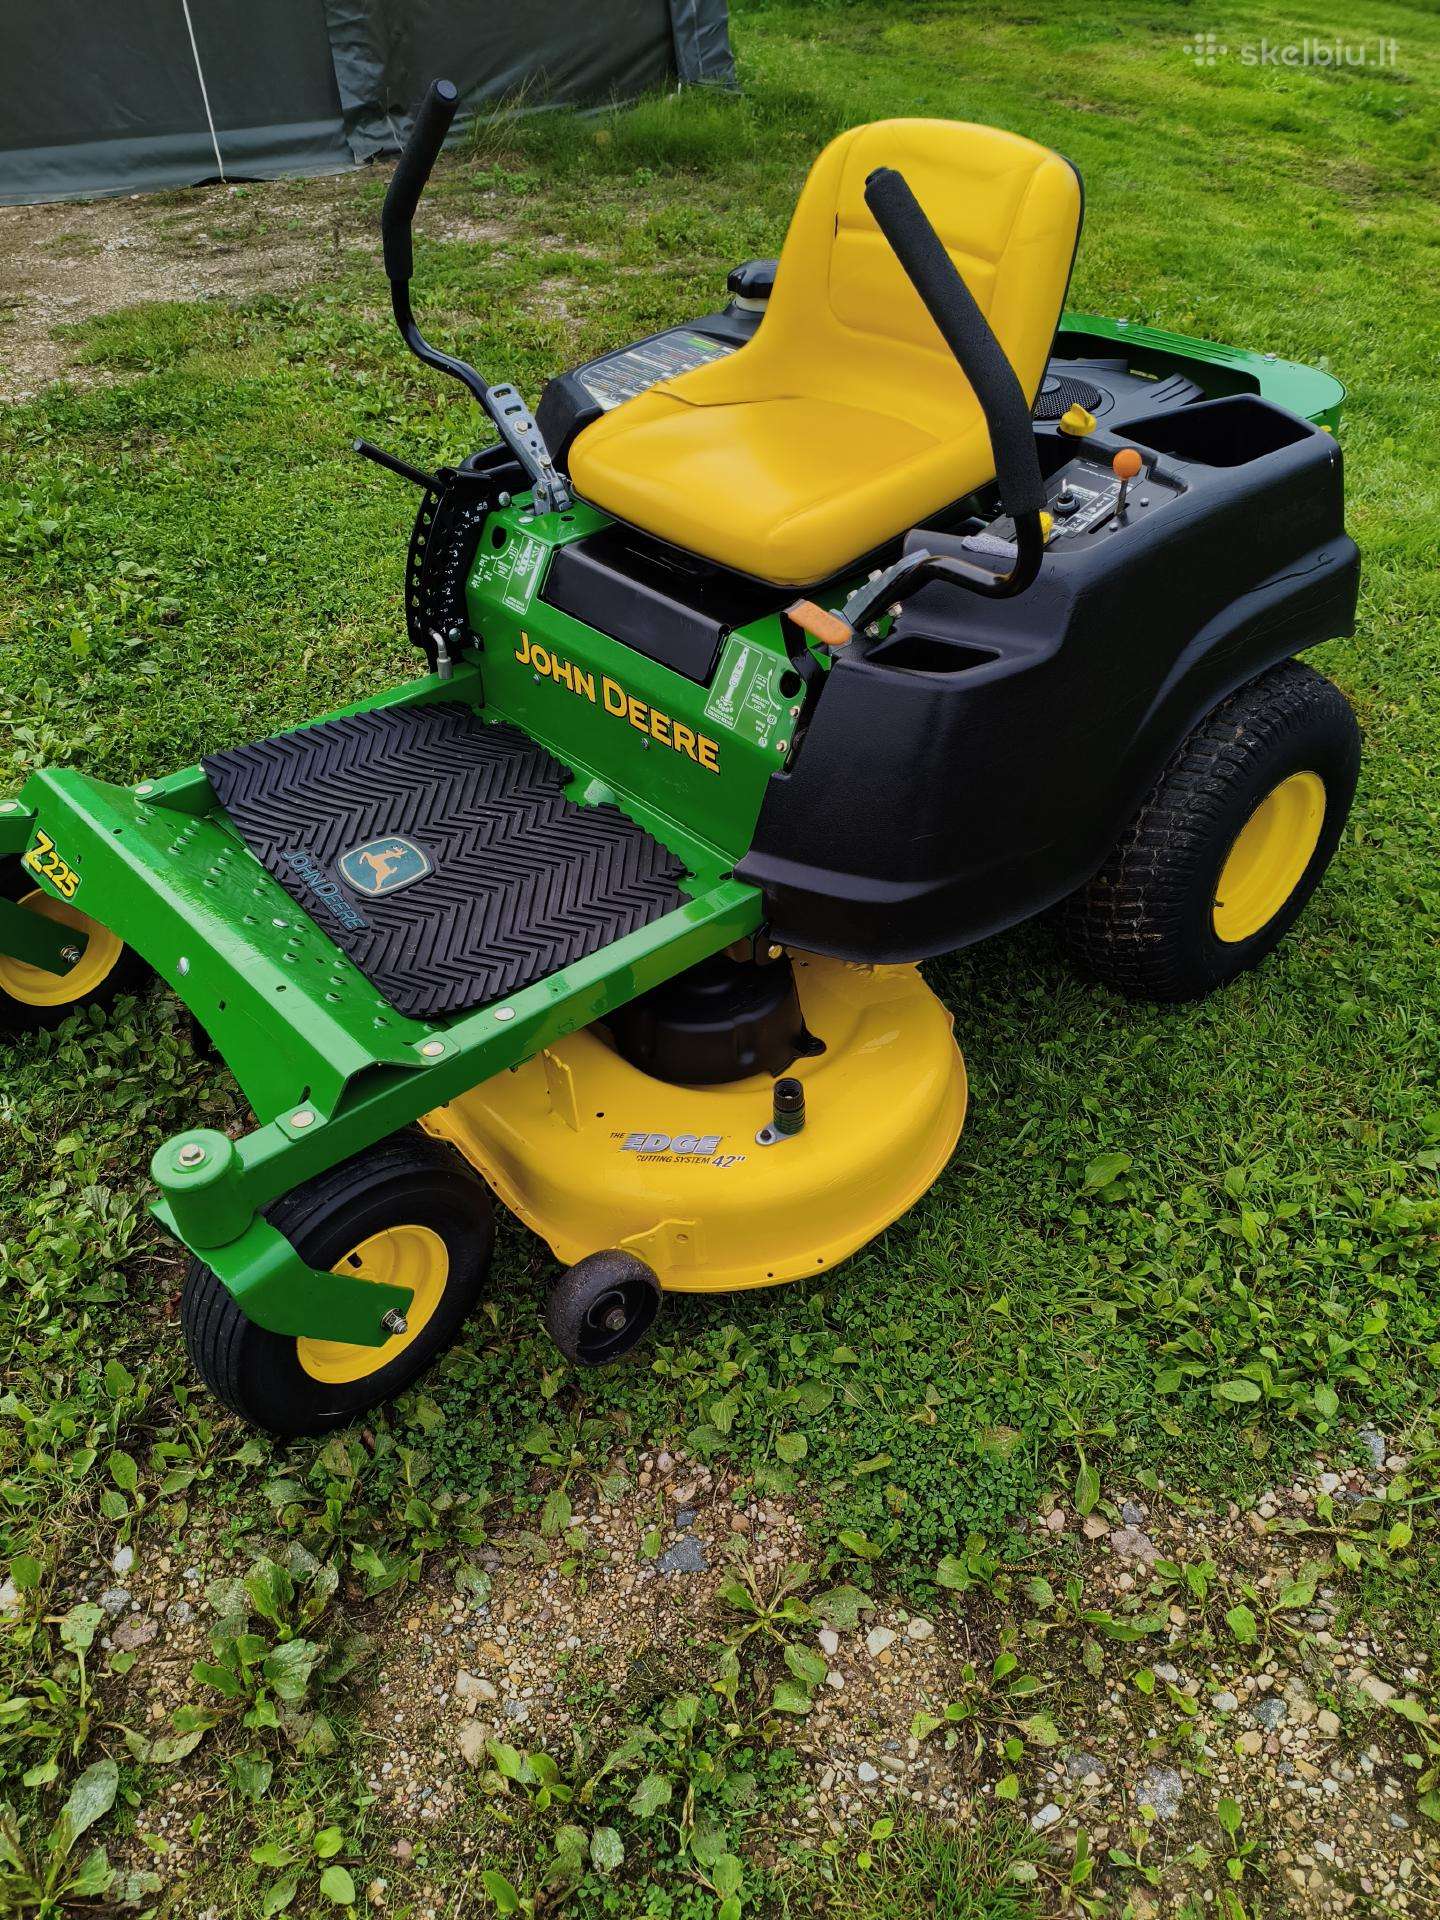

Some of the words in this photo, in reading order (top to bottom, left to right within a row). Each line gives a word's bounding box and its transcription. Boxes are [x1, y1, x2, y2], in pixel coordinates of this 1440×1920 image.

[514, 629, 596, 704] JOHN
[601, 673, 721, 775] DEERE
[24, 828, 81, 898] Z225
[281, 851, 328, 888] JOHN
[314, 882, 369, 930] DEERE
[620, 1133, 723, 1155] EDGE
[636, 1155, 673, 1163] CUTTING
[673, 1156, 711, 1164] SYSTEM
[712, 1155, 746, 1168] 42"
